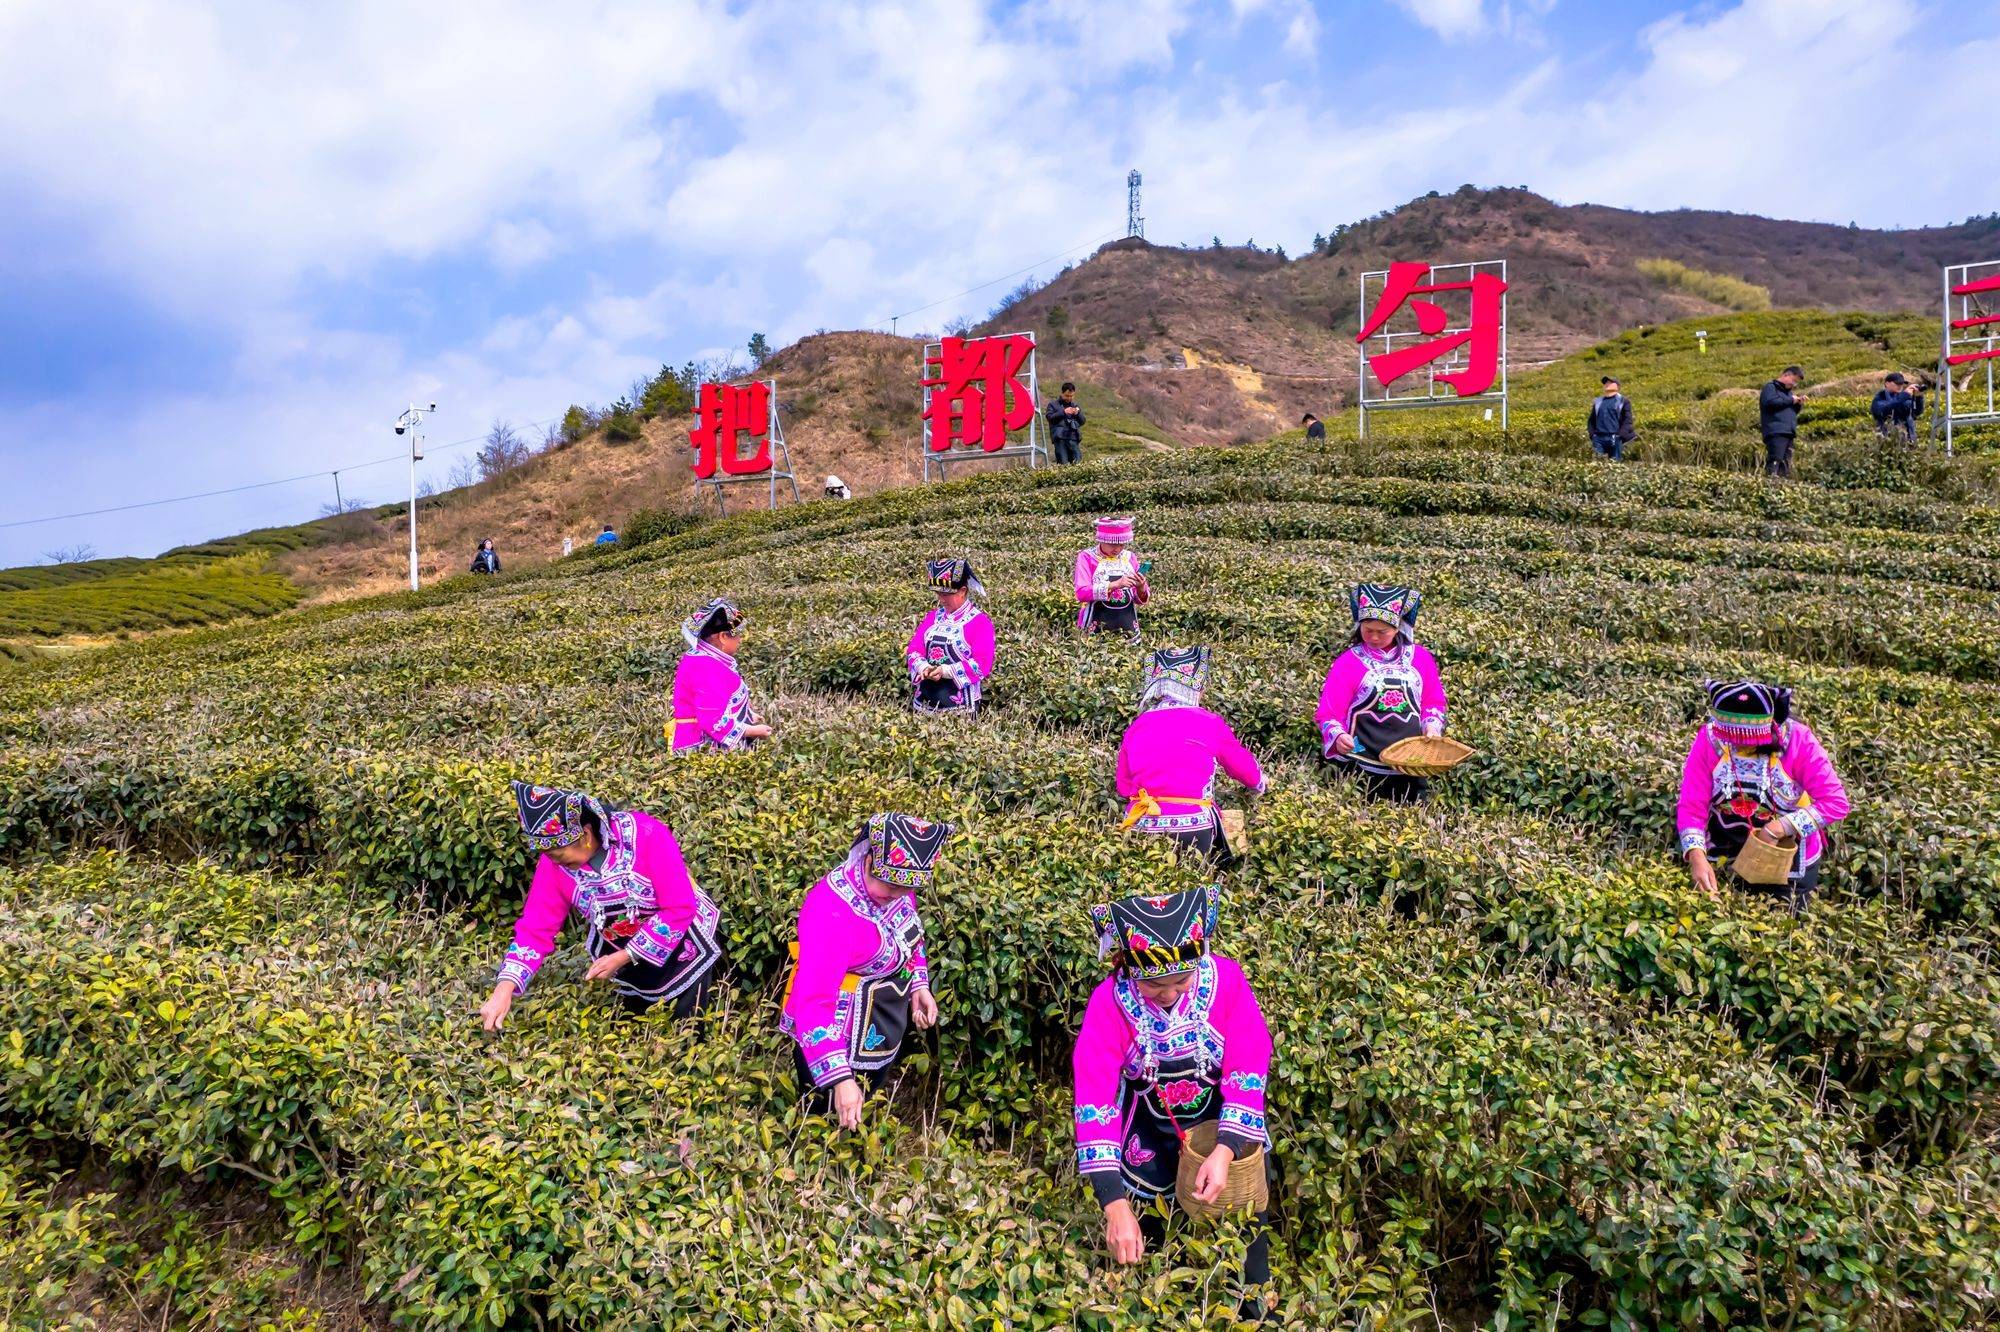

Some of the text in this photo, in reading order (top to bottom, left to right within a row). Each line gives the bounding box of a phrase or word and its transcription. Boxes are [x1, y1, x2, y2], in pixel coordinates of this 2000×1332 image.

[689, 262, 1509, 479] 把 都 匀
